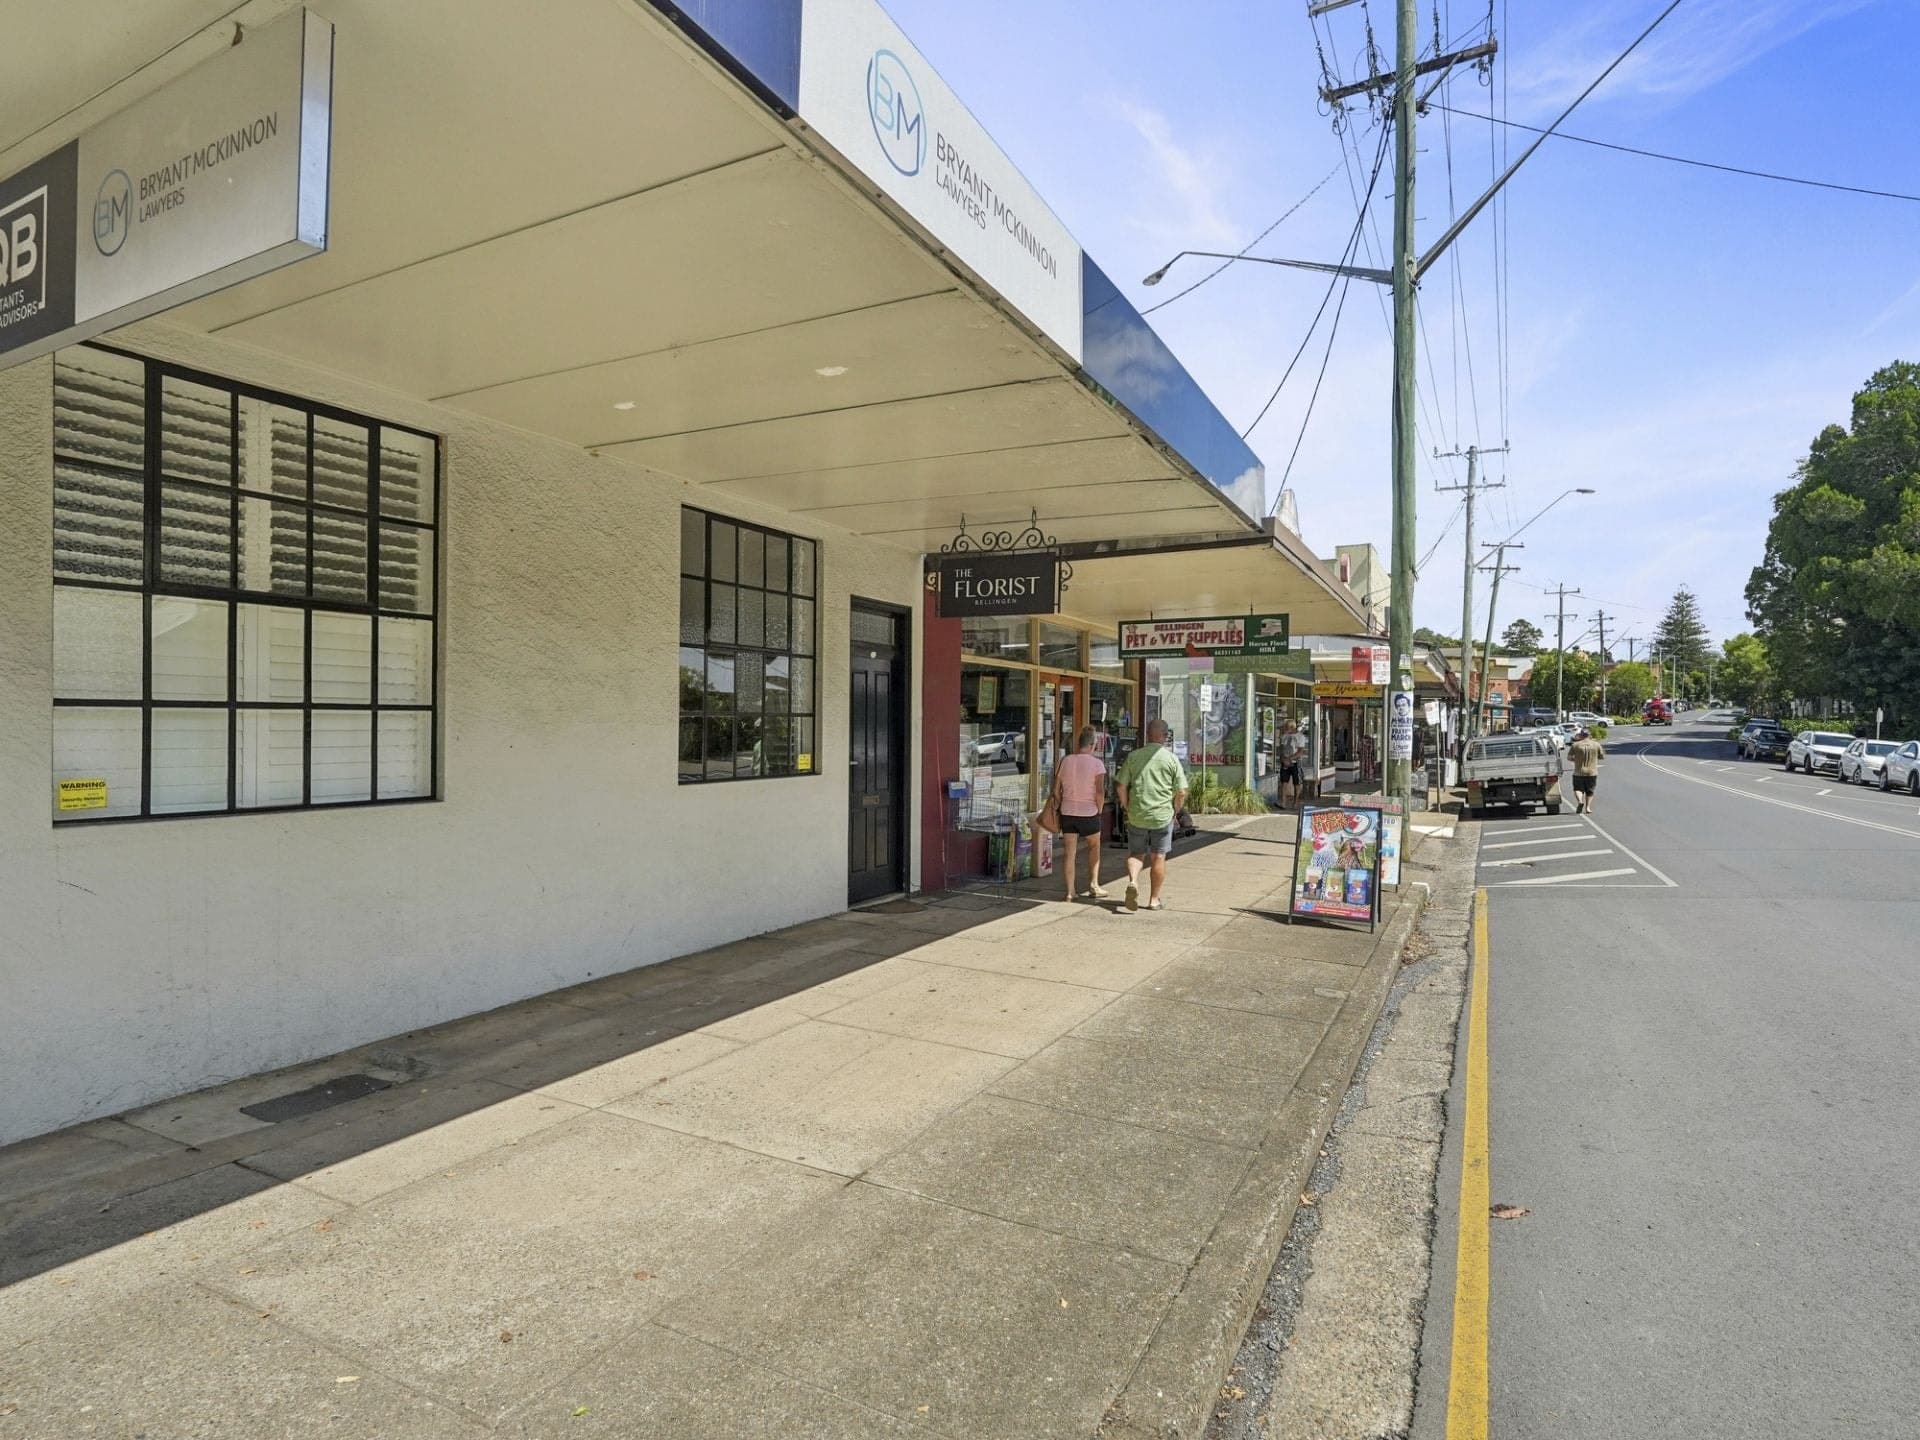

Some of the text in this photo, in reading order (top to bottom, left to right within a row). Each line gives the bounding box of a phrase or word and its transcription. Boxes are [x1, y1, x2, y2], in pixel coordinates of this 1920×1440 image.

[139, 111, 278, 201] BRYANT MCKINNON
[139, 187, 186, 223] LAWYERS
[936, 164, 987, 231] LAWYERS
[936, 132, 1057, 280] BRYANT MCKINNON
[955, 568, 974, 578] THE
[955, 576, 1041, 598] FLORIST
[974, 598, 1017, 606] BELLINGEN
[1154, 622, 1204, 632] BELLINGEN
[1126, 630, 1244, 649] PET & VET SUPPLIES
[60, 781, 106, 790] WARNING
